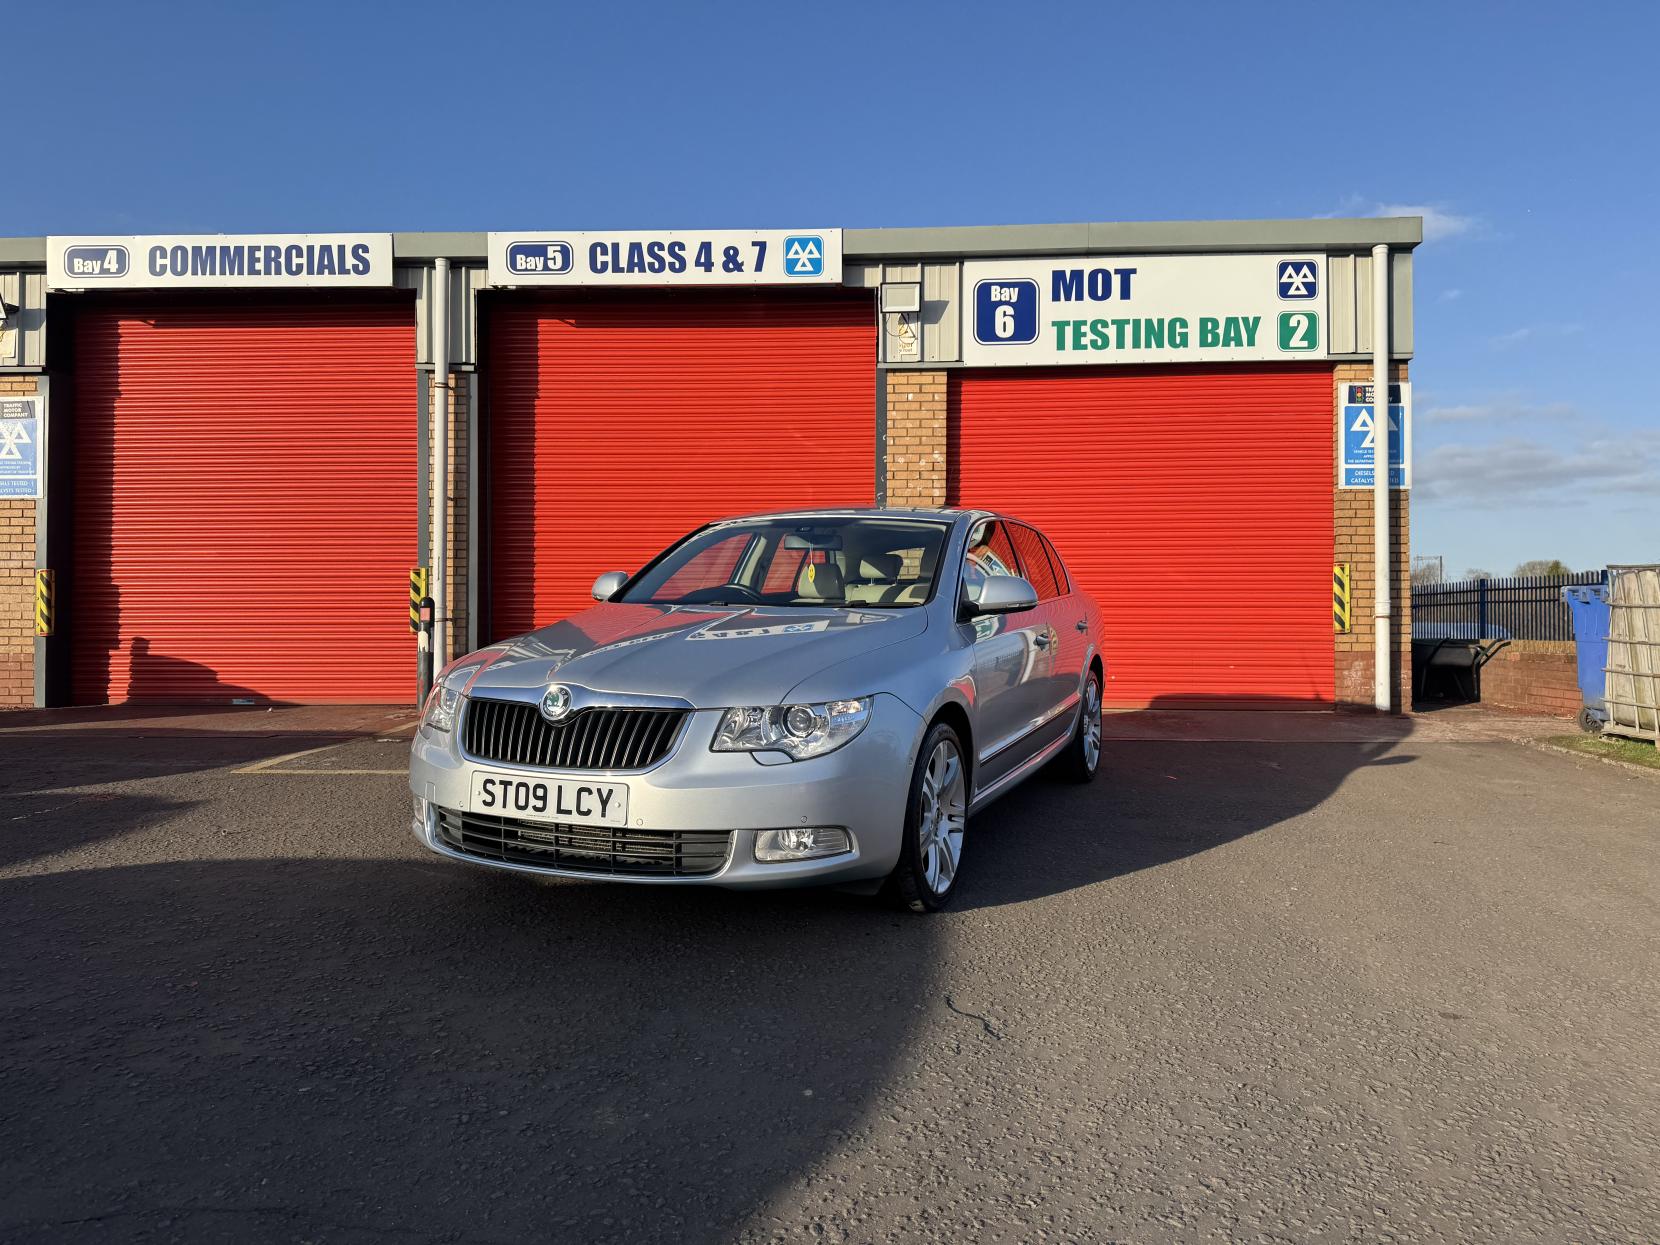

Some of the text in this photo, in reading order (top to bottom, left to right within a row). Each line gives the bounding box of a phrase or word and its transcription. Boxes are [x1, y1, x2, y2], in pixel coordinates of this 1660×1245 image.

[73, 249, 118, 275] Bay 4
[148, 244, 371, 276] COMMERCIALS
[516, 245, 563, 271] Bay 5
[588, 240, 768, 274] CLASS 4 & 7
[990, 285, 1019, 303] Bay
[1051, 268, 1137, 302] MOT
[994, 304, 1015, 339] 6
[1051, 315, 1262, 351] TESTING BAY
[1288, 314, 1308, 348] 2
[482, 778, 614, 818] ST09 LCY
